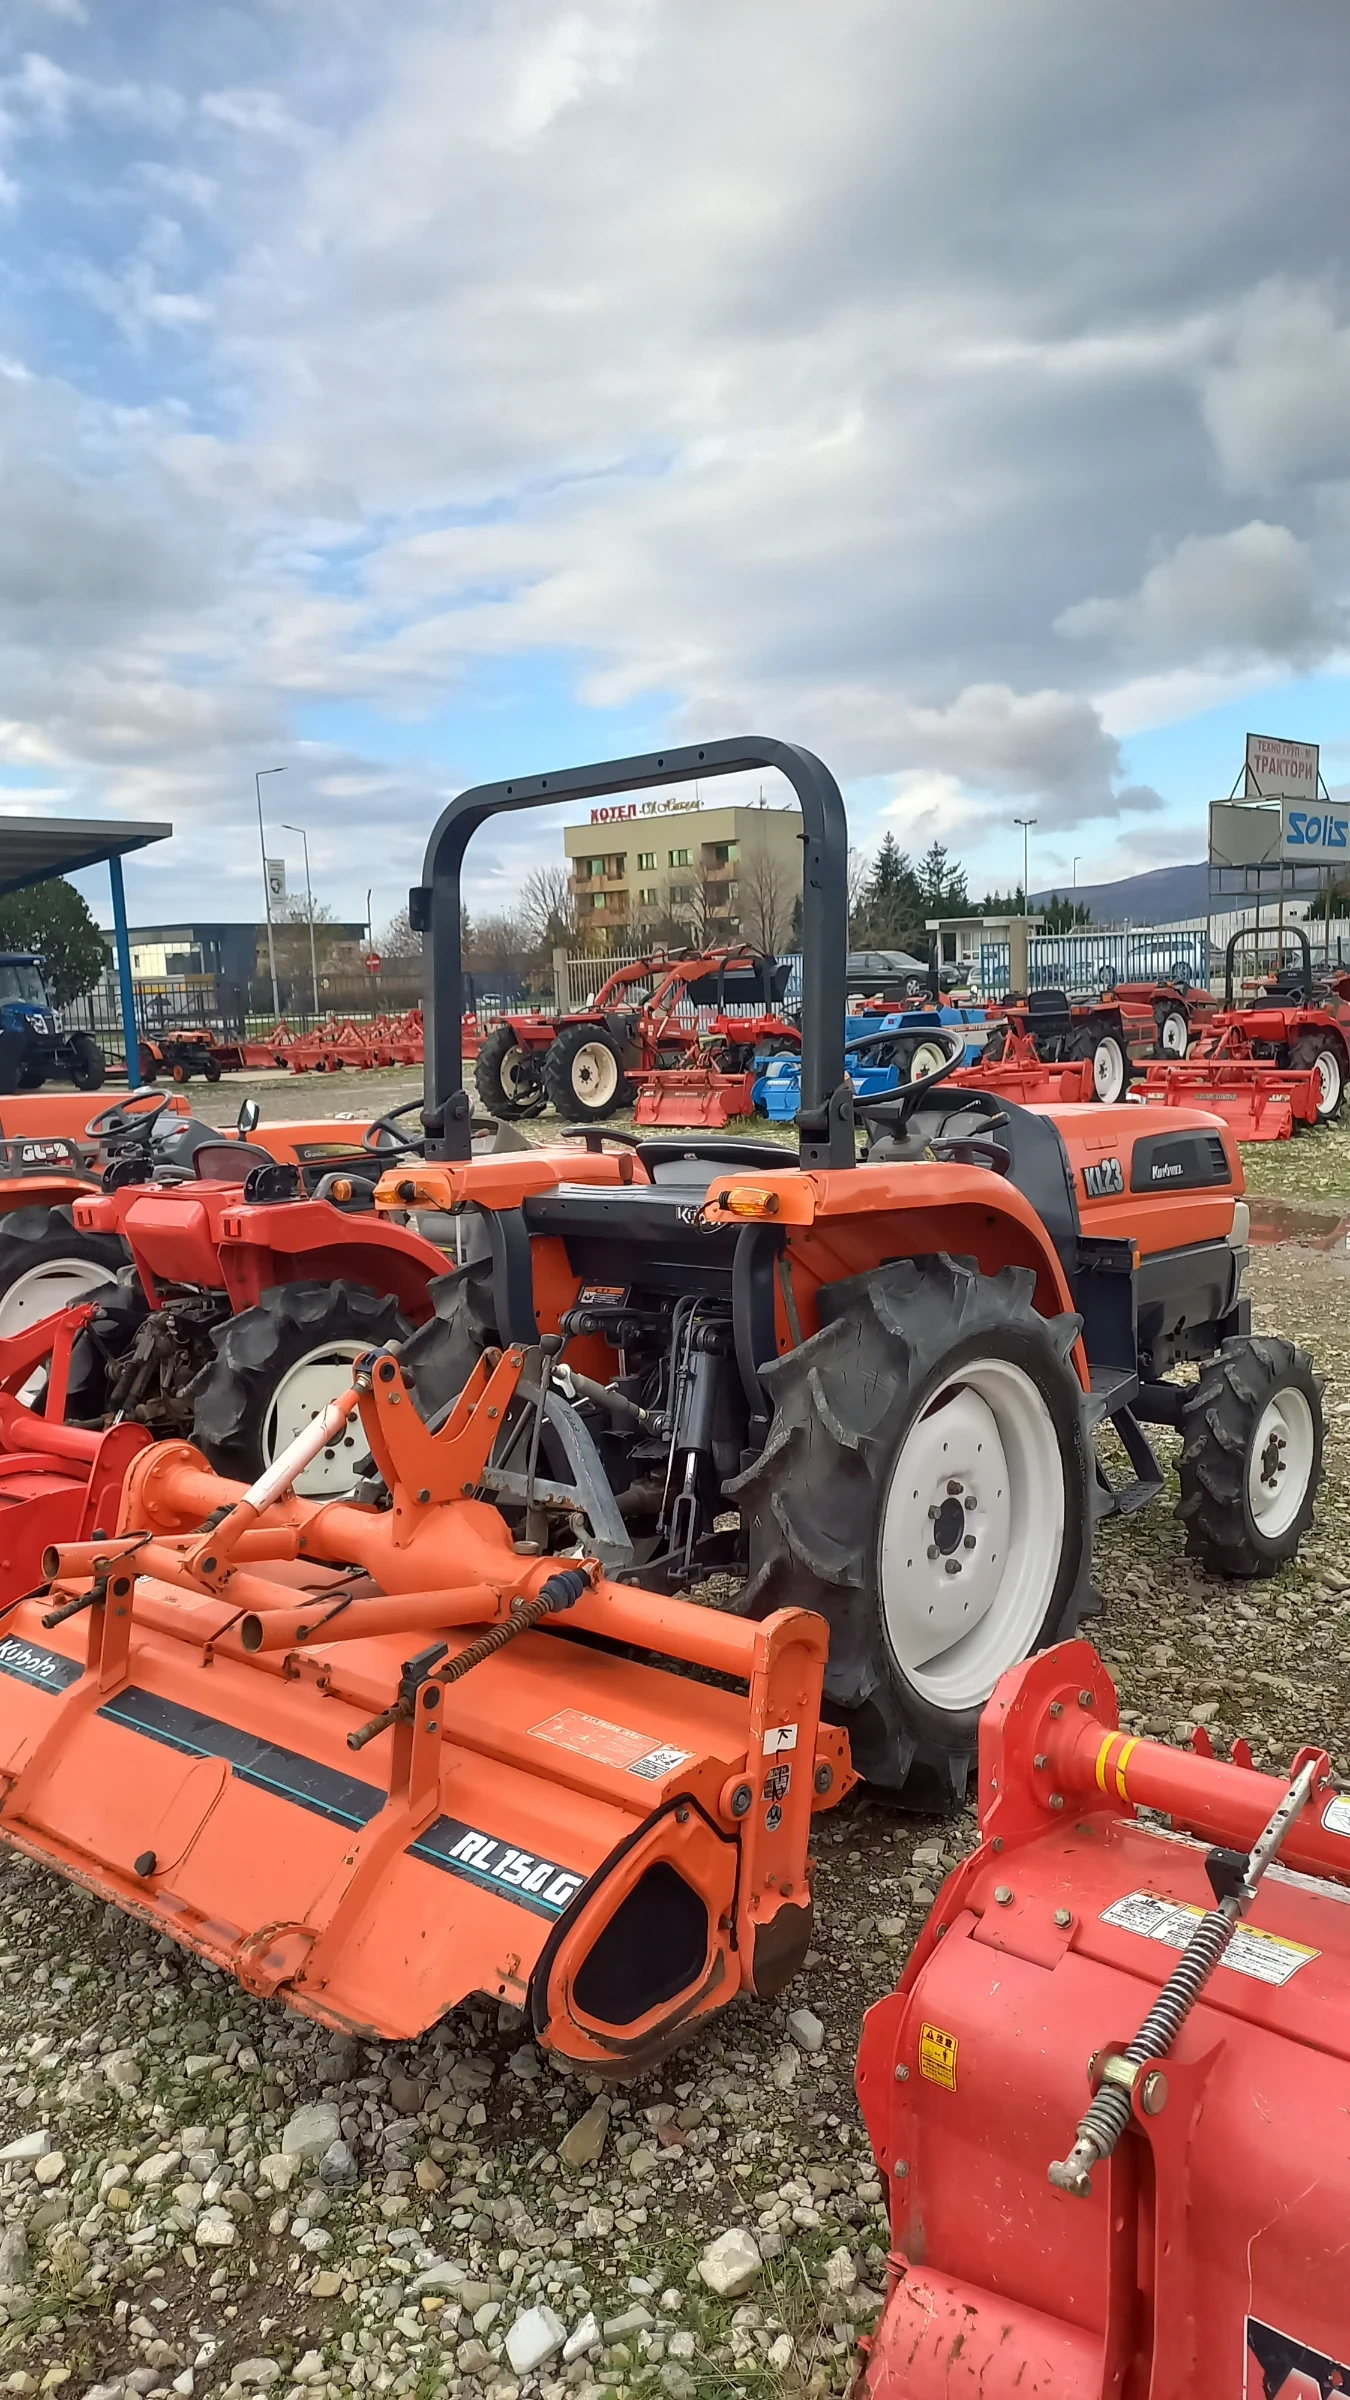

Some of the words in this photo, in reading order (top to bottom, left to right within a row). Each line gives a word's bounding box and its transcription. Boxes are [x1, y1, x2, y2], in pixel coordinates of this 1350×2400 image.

[1258, 740, 1280, 753] ТЕХНО
[1282, 744, 1300, 757] ГРУП
[1254, 755, 1312, 780] ТРАКТОРИ
[22, 1141, 70, 1161] GL-2
[1084, 1158, 1124, 1196] KL23
